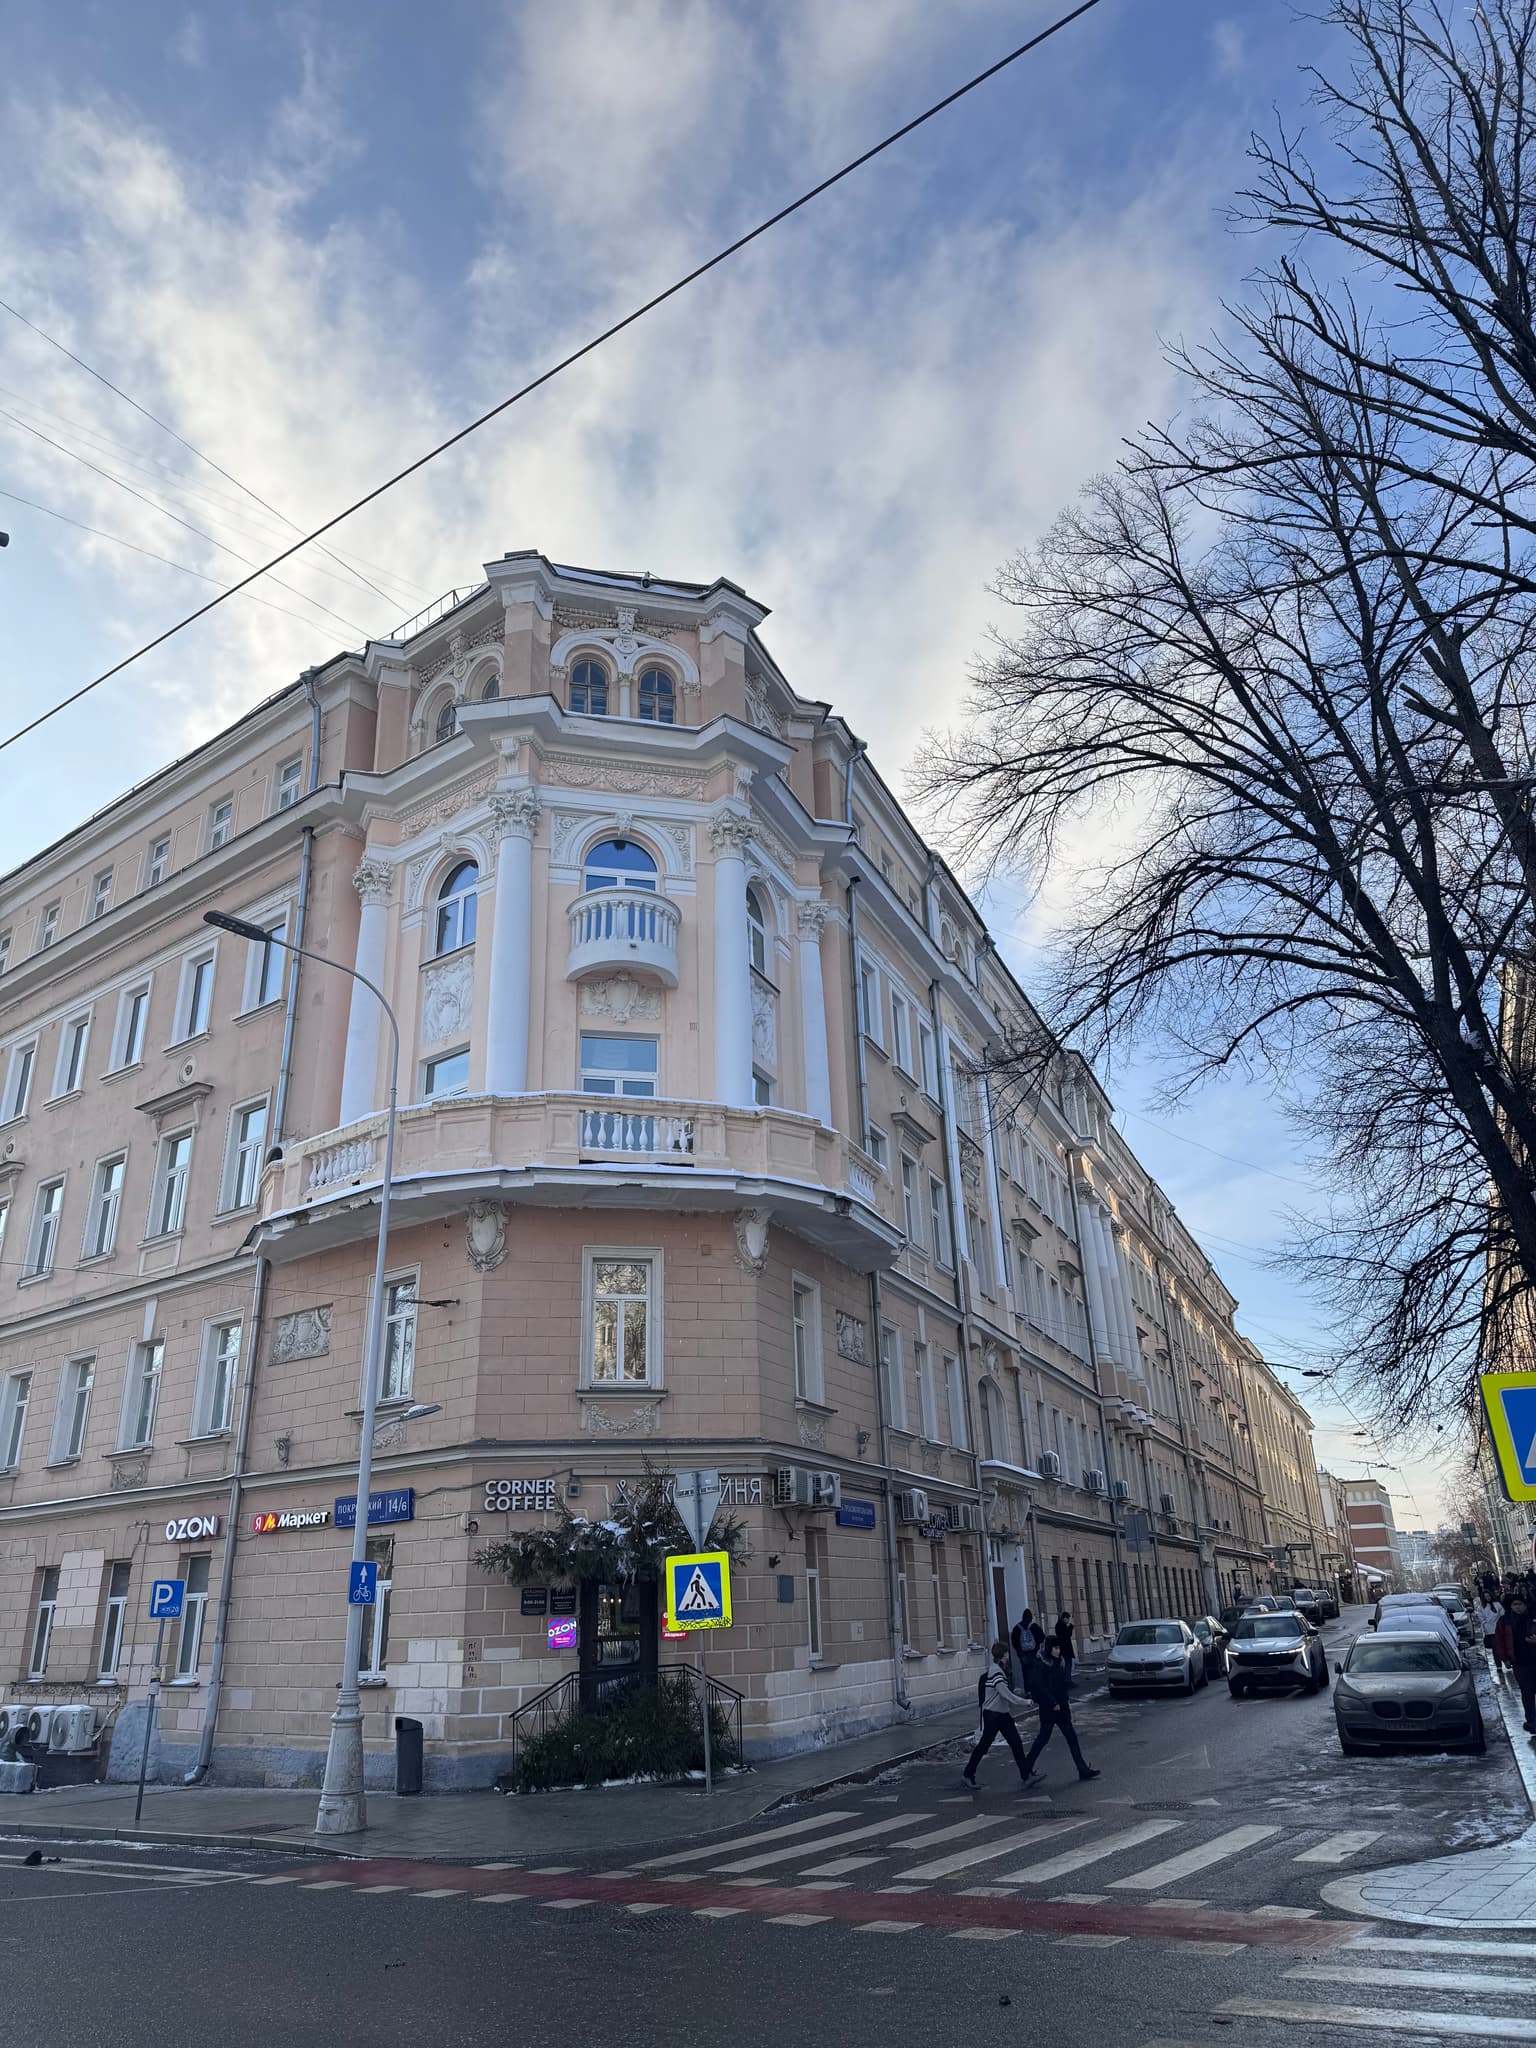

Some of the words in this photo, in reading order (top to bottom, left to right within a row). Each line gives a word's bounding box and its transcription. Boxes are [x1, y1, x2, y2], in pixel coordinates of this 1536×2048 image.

[485, 1479, 556, 1495] CORNER
[662, 1476, 762, 1505] КЙНЯ
[337, 1498, 382, 1514] ПОКРКИЙ
[388, 1497, 407, 1513] 14/6
[484, 1495, 555, 1511] COFFEE
[165, 1515, 216, 1541] OZON
[277, 1511, 328, 1528] Маркет
[153, 1584, 174, 1614] P
[548, 1620, 577, 1637] OZON
